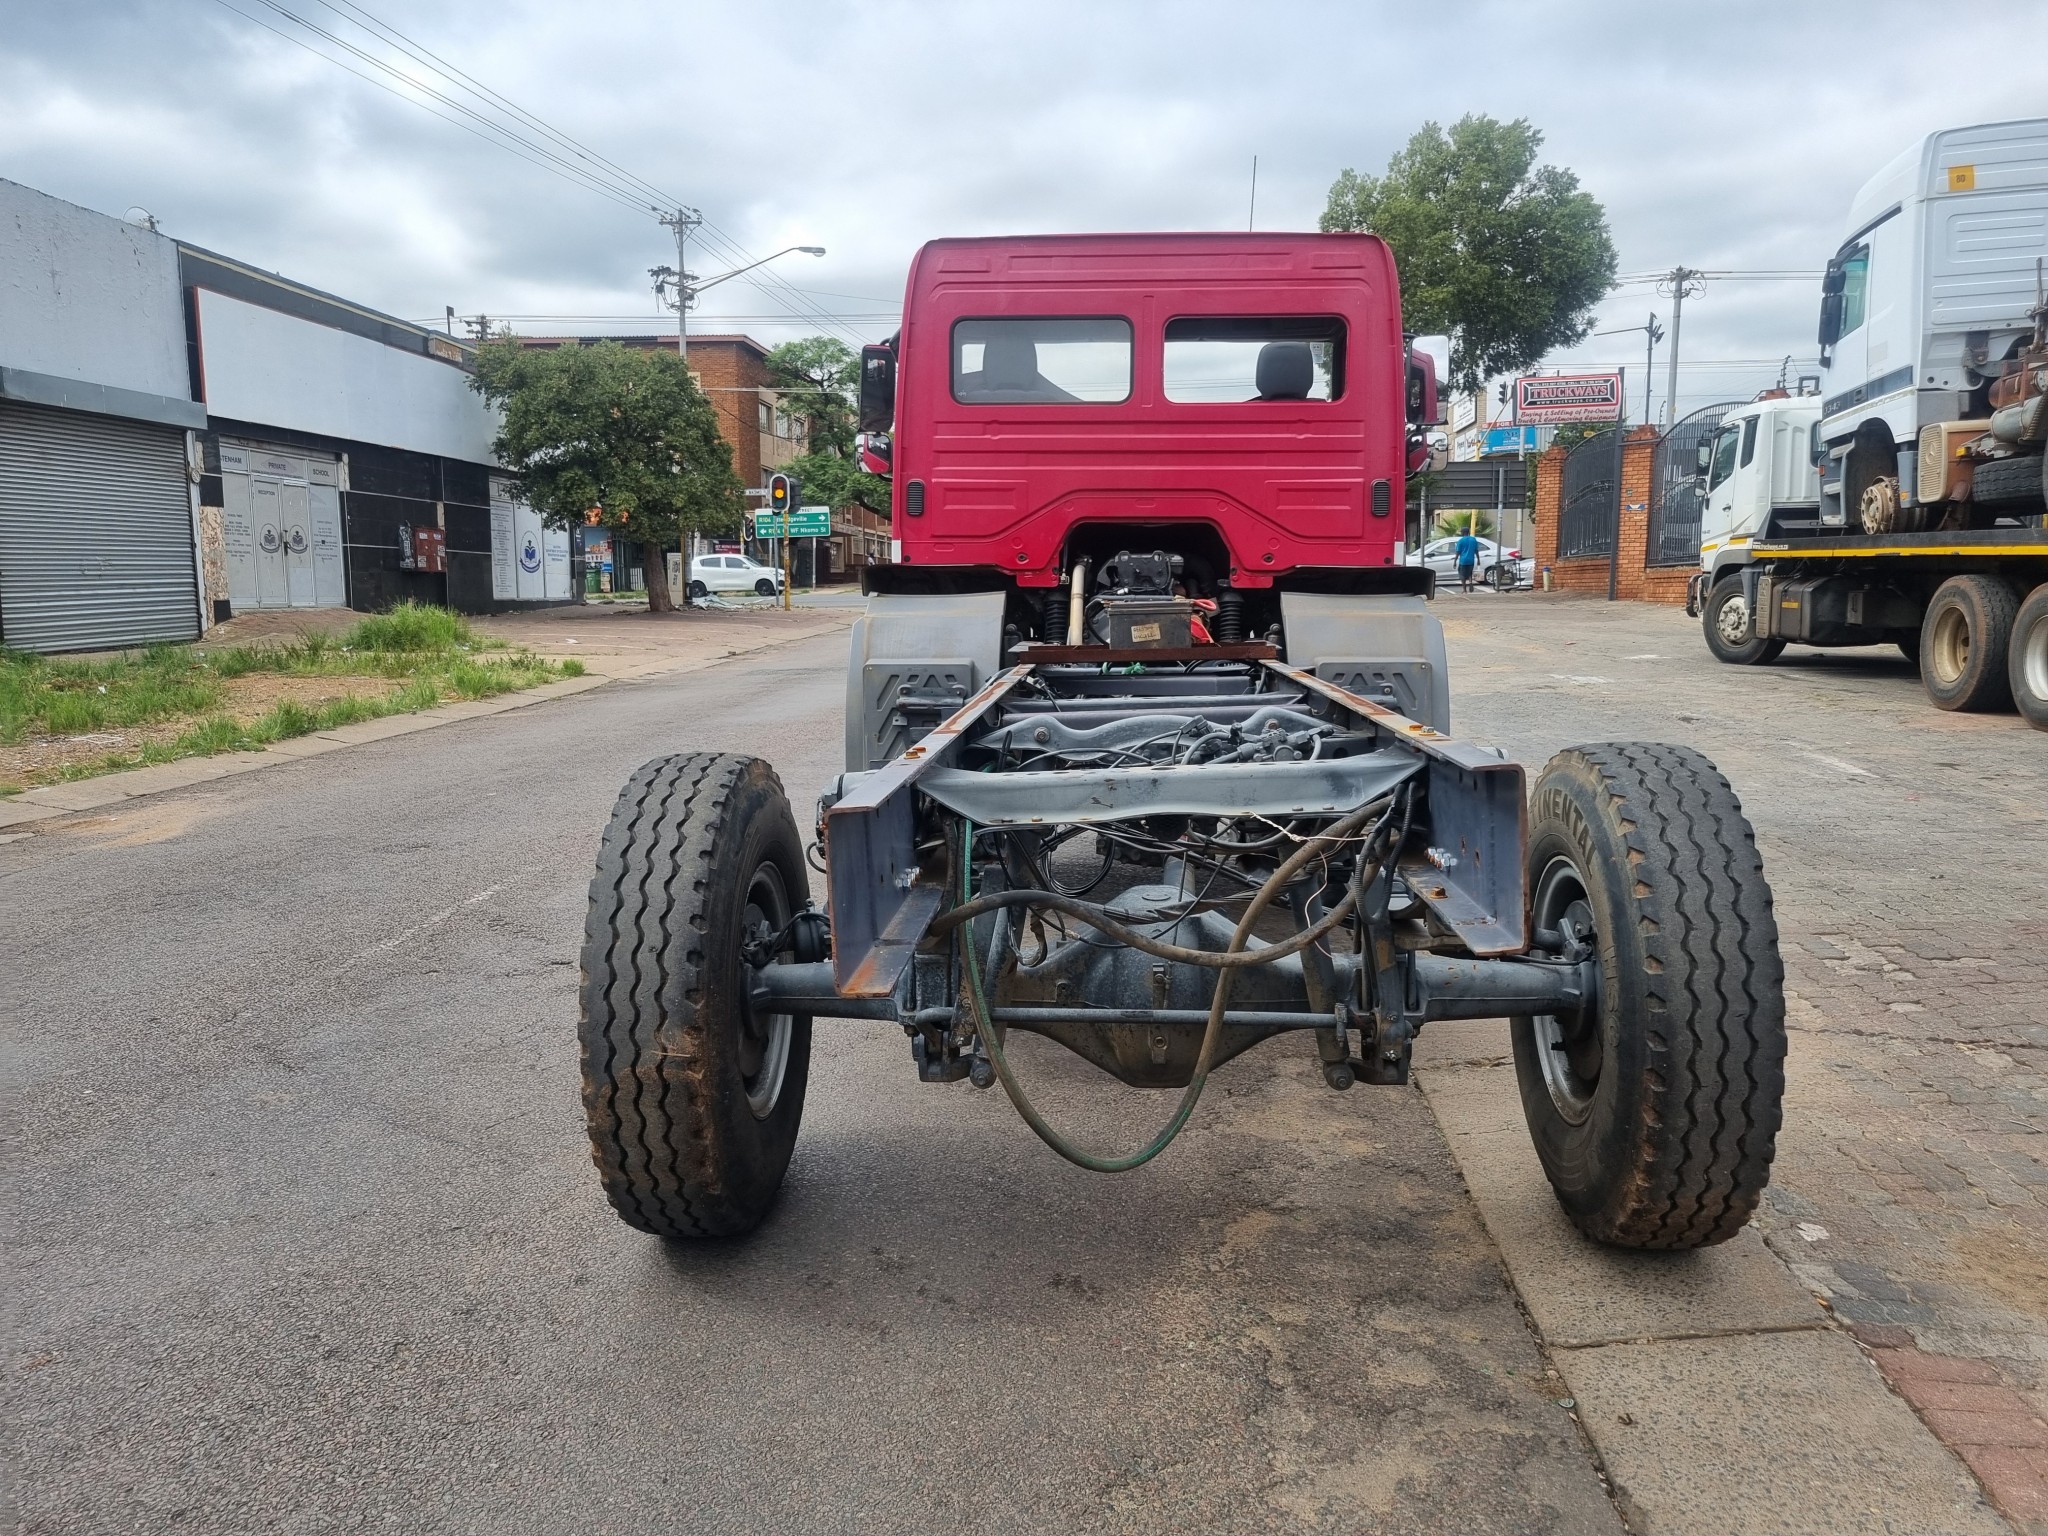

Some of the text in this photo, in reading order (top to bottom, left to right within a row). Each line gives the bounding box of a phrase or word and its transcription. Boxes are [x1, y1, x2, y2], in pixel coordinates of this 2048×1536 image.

[1531, 385, 1607, 399] TRUCKWAYS
[1520, 410, 1543, 418] Buying
[1551, 409, 1574, 417] Selling
[1583, 407, 1616, 415] Pre-Owned
[1517, 416, 1537, 424] Trucks
[221, 455, 242, 463] TENHAM
[268, 462, 286, 471] PRIVATE
[312, 468, 330, 477] SCHOOL
